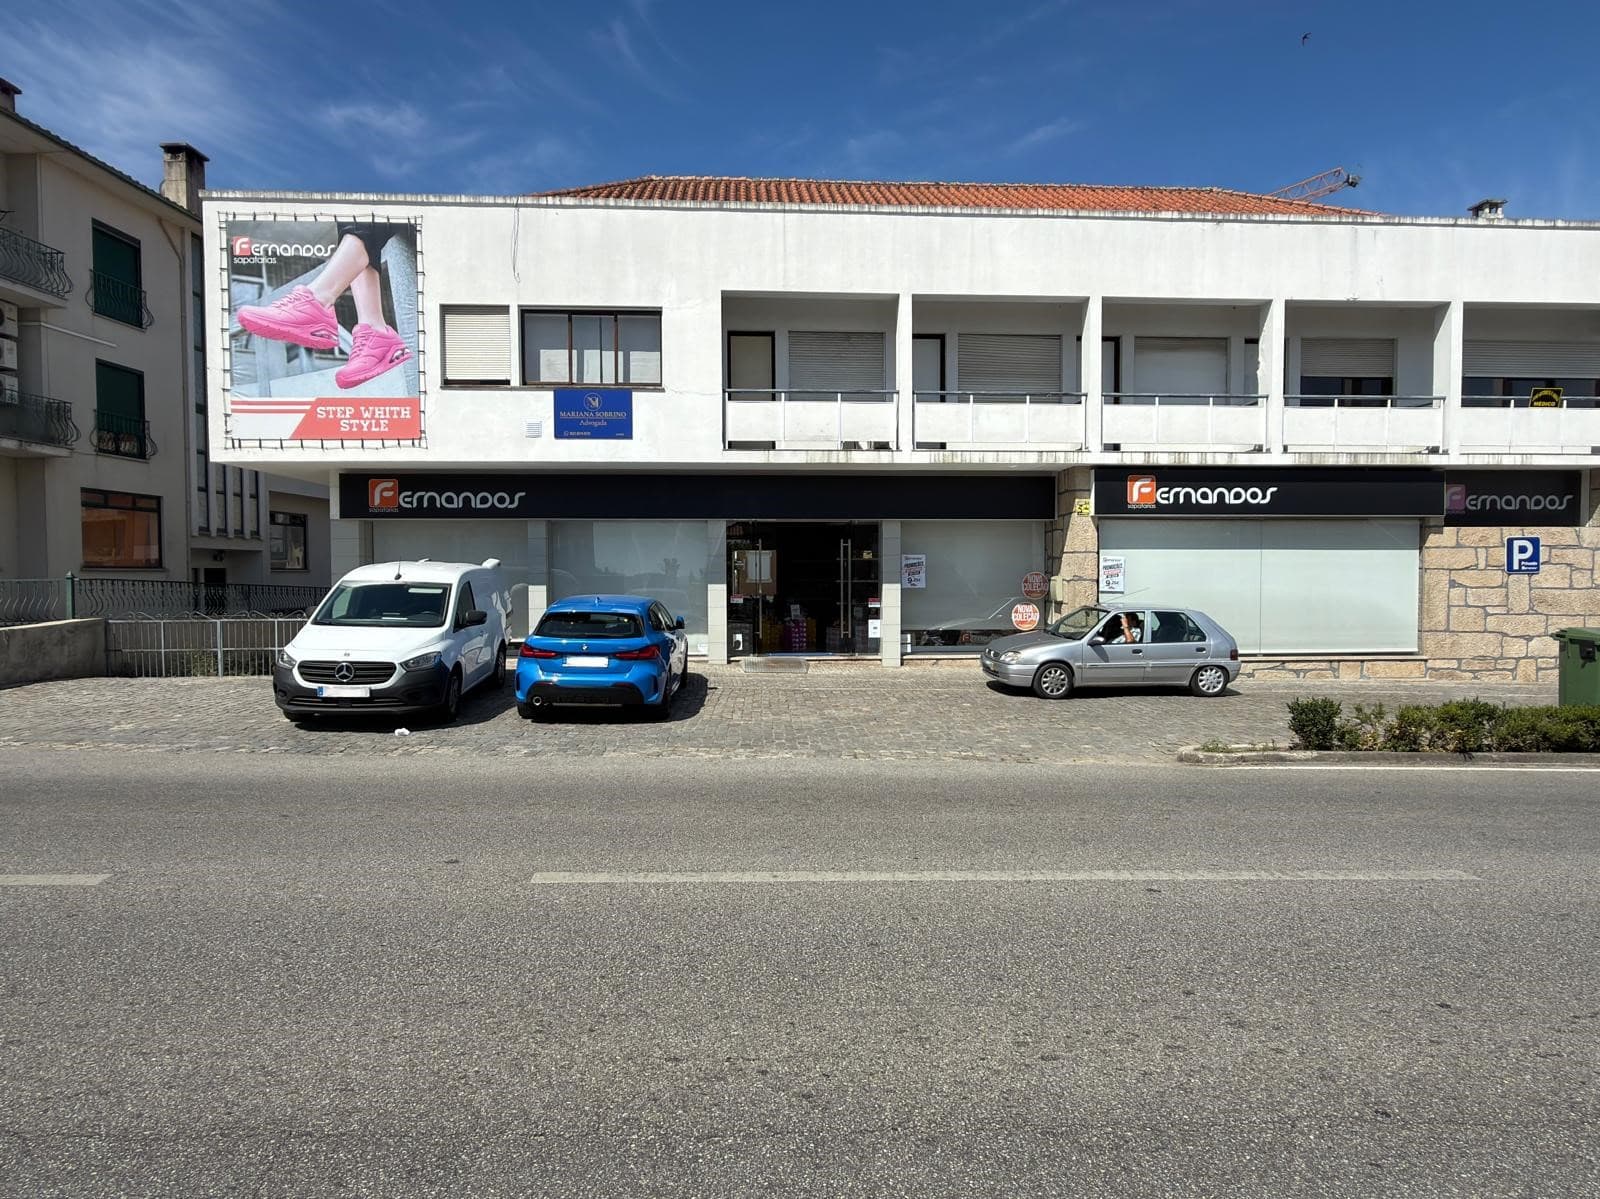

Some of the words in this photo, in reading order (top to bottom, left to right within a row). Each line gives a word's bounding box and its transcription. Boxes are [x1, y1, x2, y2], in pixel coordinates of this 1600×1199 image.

[316, 406, 355, 419] STEP
[360, 406, 412, 419] WHITH
[340, 419, 389, 432] STYLE
[579, 419, 607, 427] Advogada
[1513, 539, 1534, 570] P
[1017, 604, 1032, 613] NOVA
